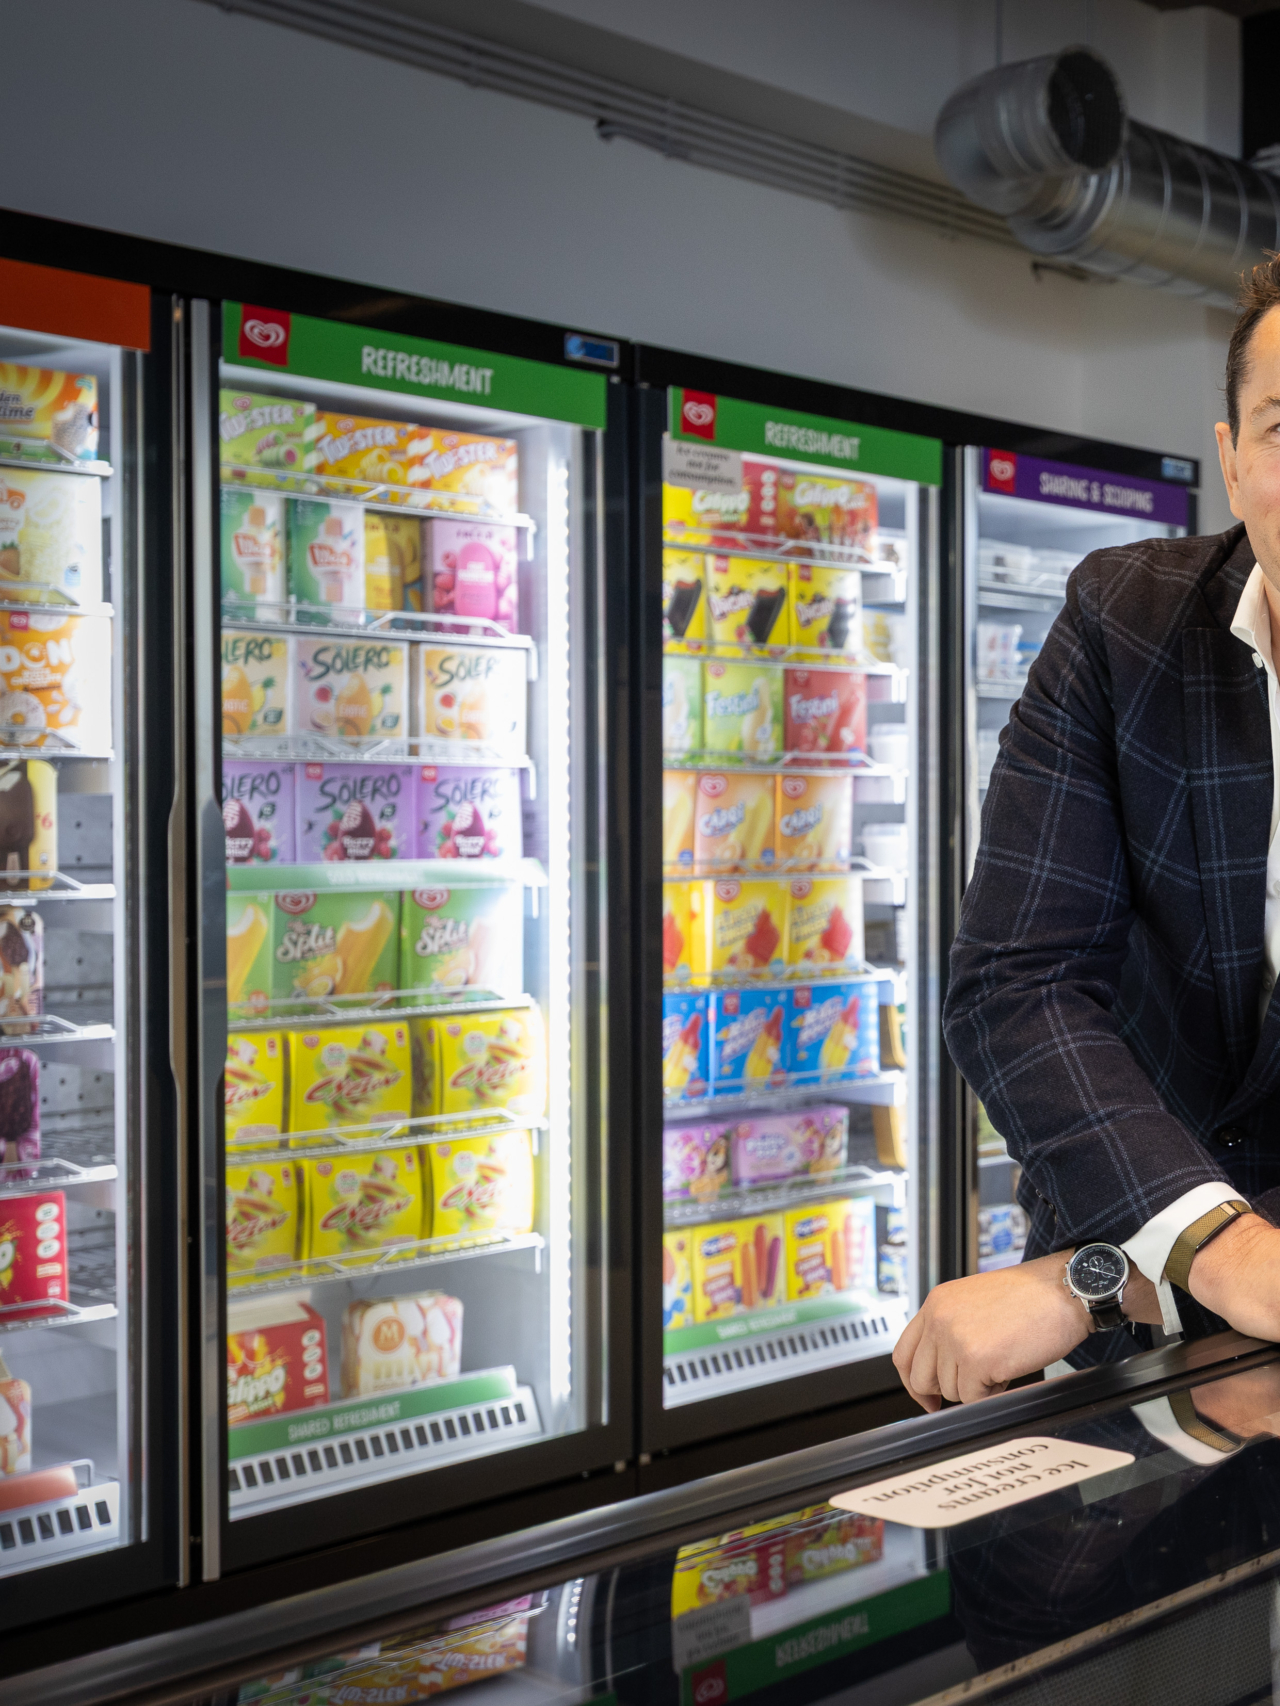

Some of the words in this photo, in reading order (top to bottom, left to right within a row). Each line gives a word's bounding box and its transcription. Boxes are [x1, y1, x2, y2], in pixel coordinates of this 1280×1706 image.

[361, 345, 494, 396] REFRESHMENT
[764, 421, 861, 460] REFRESHMENT
[1039, 472, 1088, 501] SHARING
[1089, 482, 1099, 504] &
[221, 637, 272, 667] LERO
[437, 652, 500, 688] SOLER
[221, 771, 280, 801] OLERO
[227, 1366, 286, 1400] alippo
[332, 1401, 400, 1430] REFRESHMENT
[862, 1443, 1050, 1503] consumption.
[987, 1462, 1033, 1482] not
[1047, 1459, 1090, 1476] Ice
[937, 1473, 1042, 1512] creams
[942, 1474, 989, 1497] for
